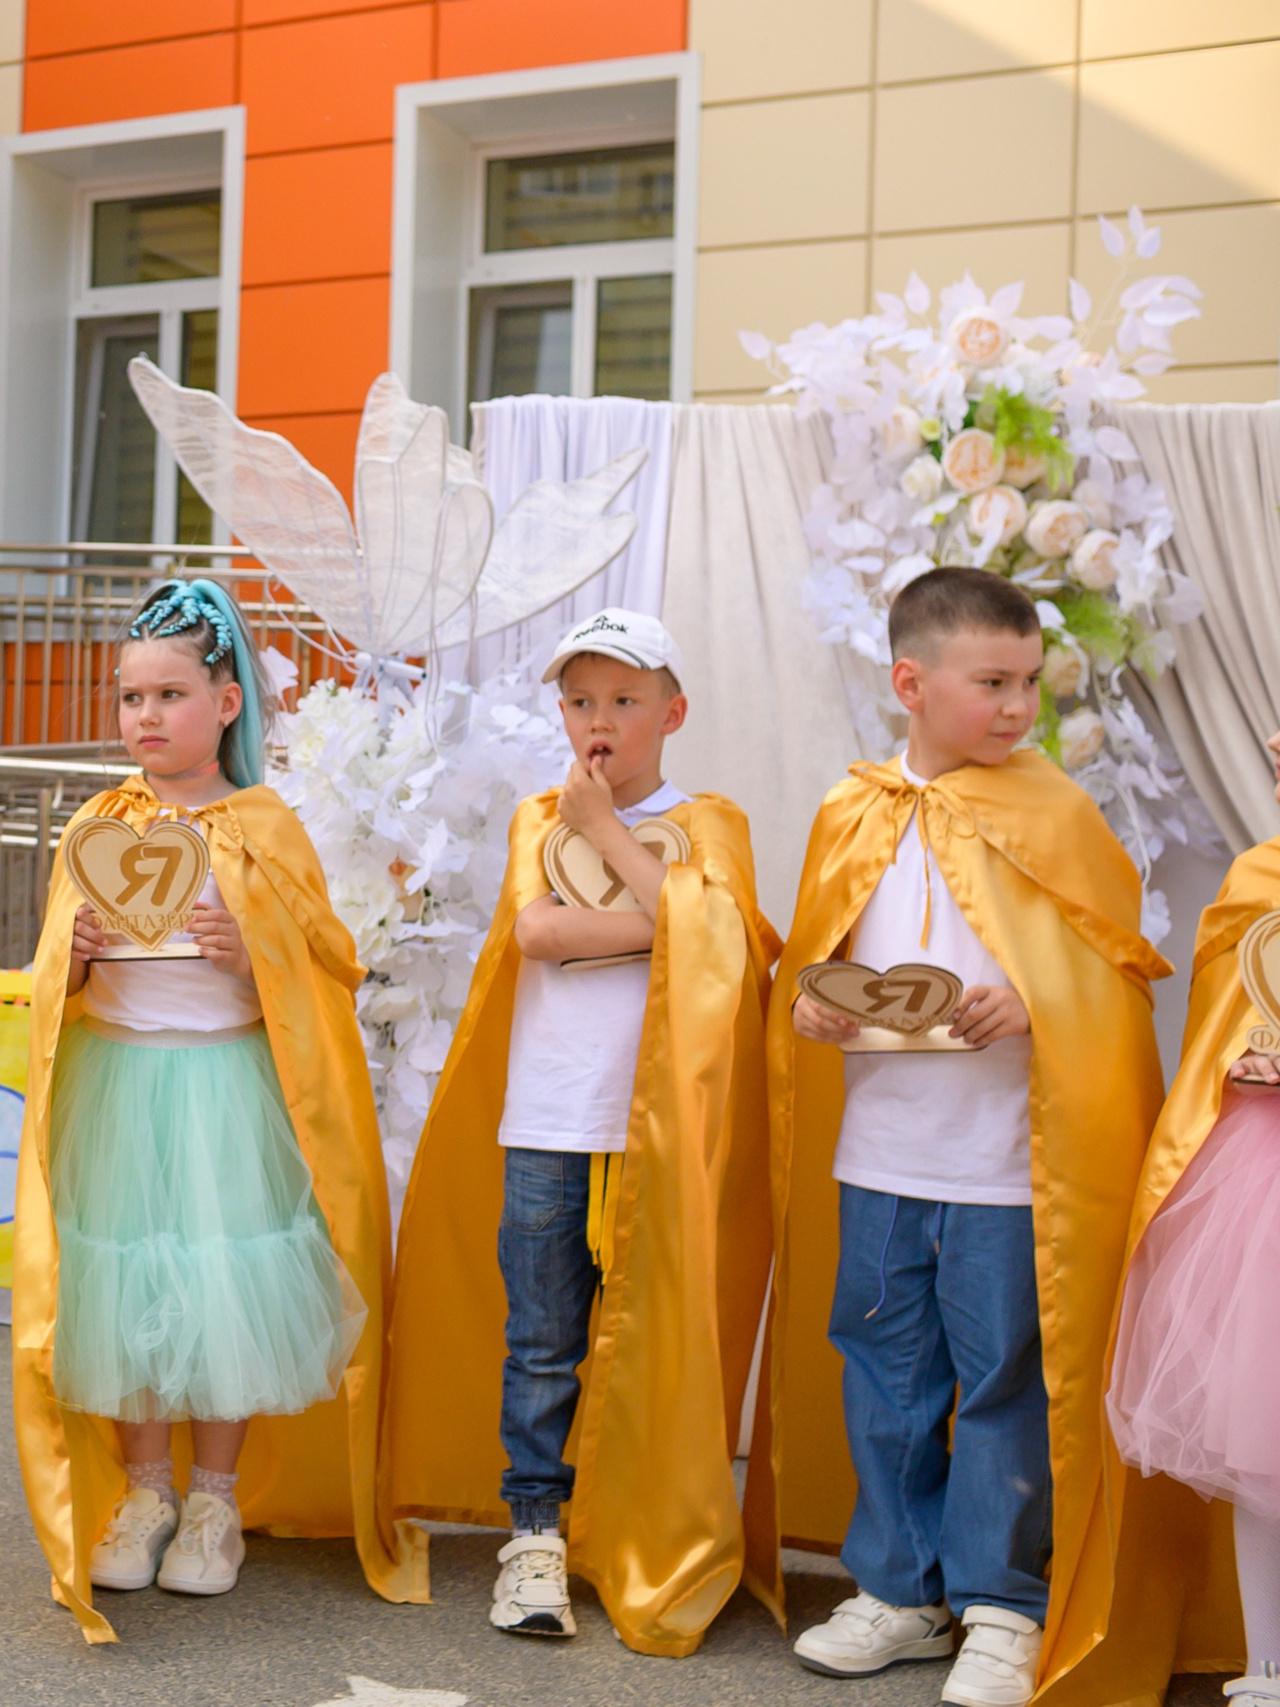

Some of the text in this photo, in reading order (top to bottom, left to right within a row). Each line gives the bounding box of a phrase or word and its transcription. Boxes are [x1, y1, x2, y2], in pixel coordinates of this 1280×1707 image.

[114, 841, 184, 908] Я
[93, 910, 196, 931] АНТАЗЁР
[863, 979, 933, 1014] Я
